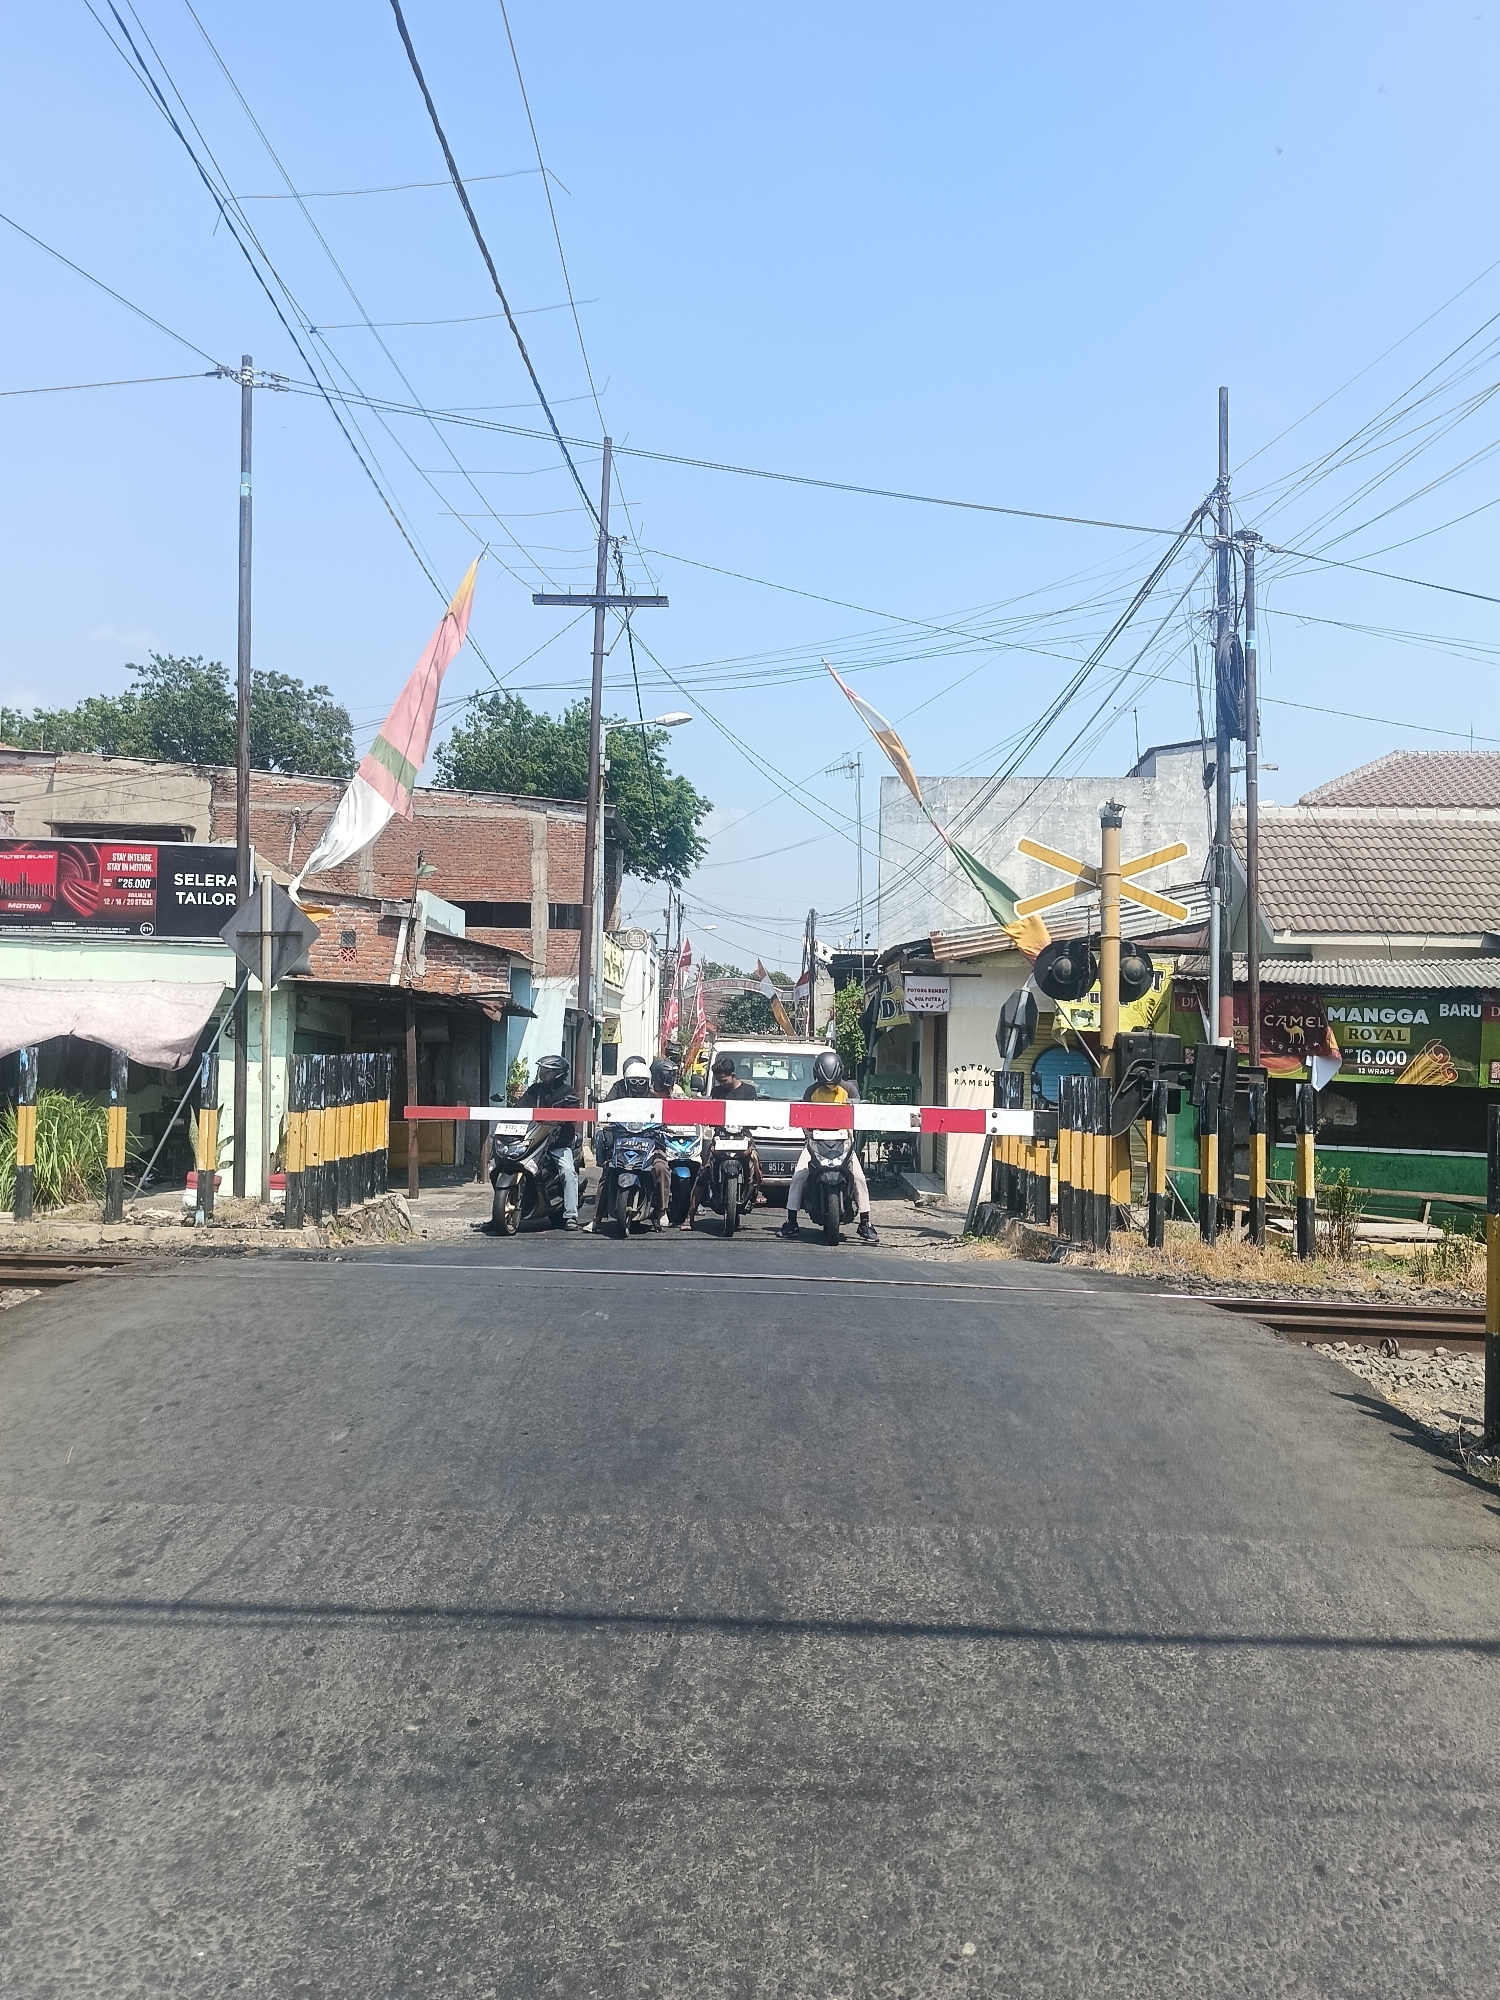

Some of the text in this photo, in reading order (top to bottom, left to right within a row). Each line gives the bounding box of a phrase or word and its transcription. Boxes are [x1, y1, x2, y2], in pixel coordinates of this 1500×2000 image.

[112, 852, 126, 862] STAY
[107, 862, 121, 871] STAY
[174, 873, 237, 887] SELERA
[8, 902, 42, 910] MOTION
[176, 892, 237, 906] TAILOR
[1327, 1005, 1430, 1025] MANGGA
[1439, 1003, 1482, 1018] BARU
[1264, 1014, 1325, 1028] CAMEL
[1347, 1027, 1407, 1042] ROYAL
[1355, 1049, 1408, 1067] 16.000
[1367, 1067, 1395, 1075] WRAPS
[768, 1162, 785, 1172] 9512
